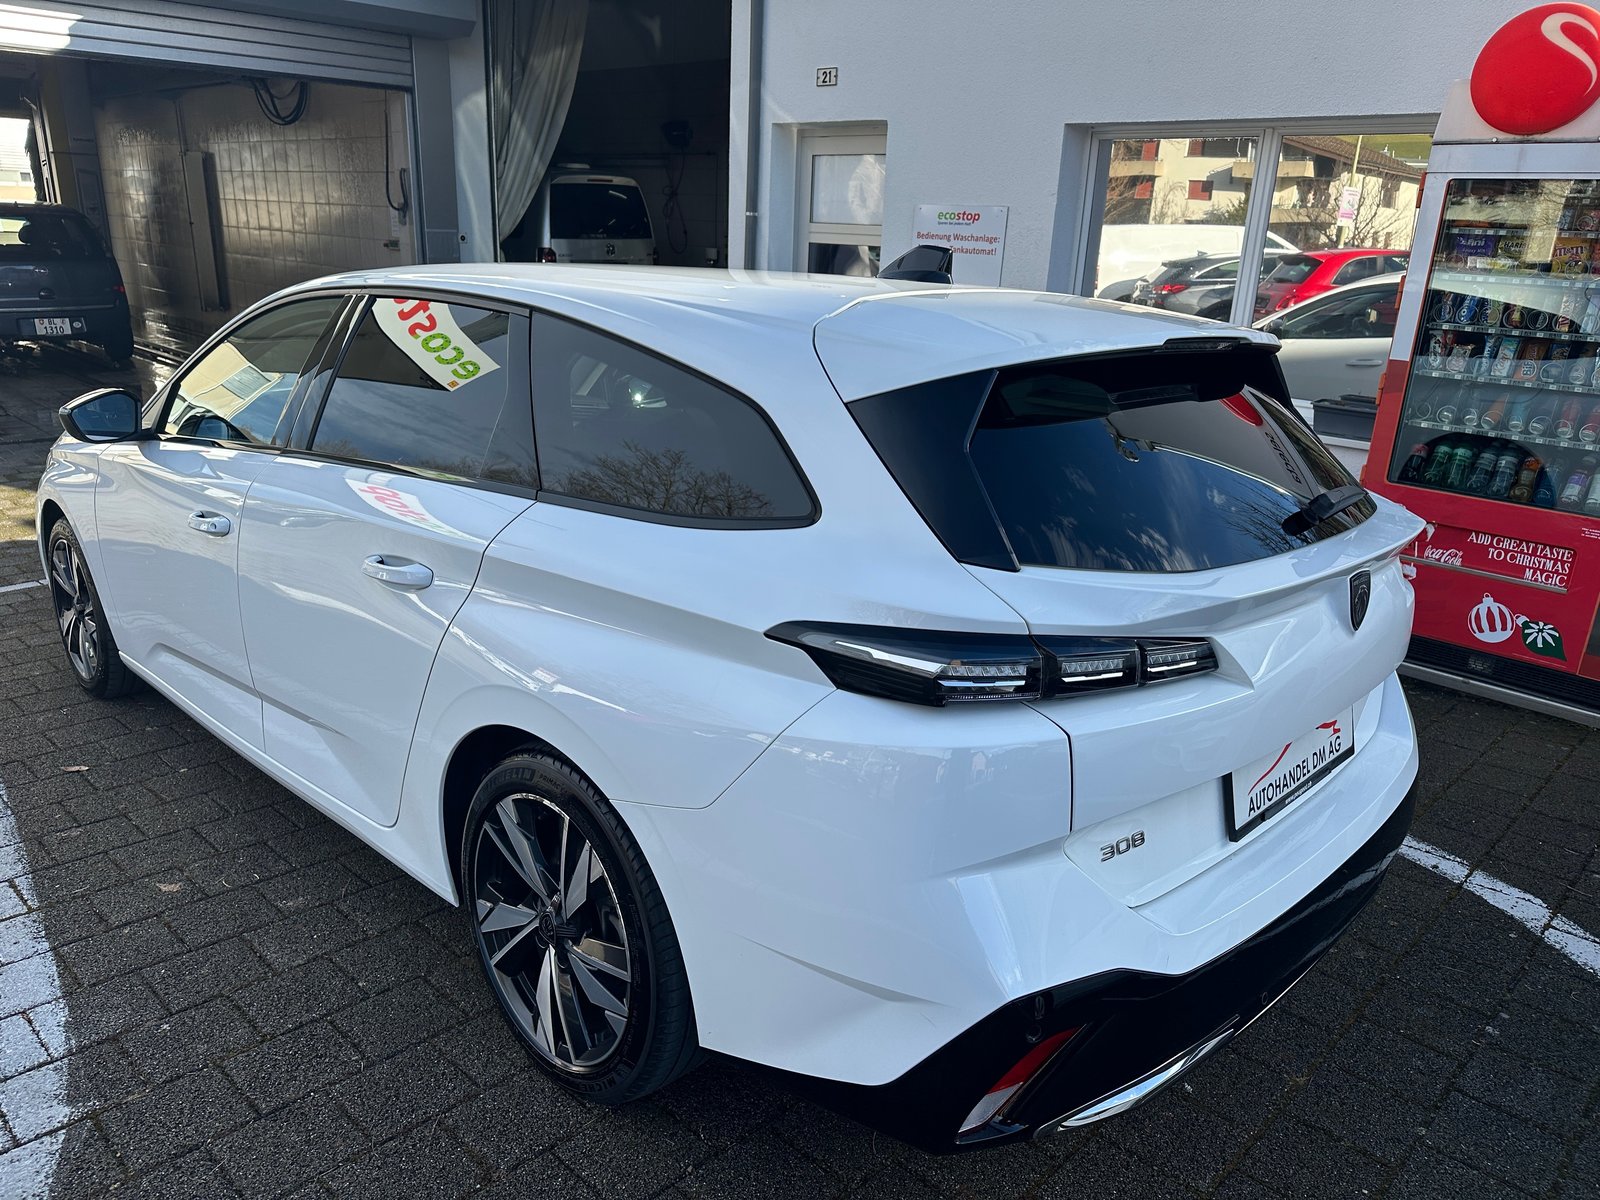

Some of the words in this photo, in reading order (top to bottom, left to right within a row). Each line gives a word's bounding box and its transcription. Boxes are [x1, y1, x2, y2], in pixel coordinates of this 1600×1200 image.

[821, 70, 832, 84] 21
[937, 210, 981, 224] ecostop
[916, 231, 952, 242] Bedienung
[953, 232, 1001, 244] Waschanlage:
[1503, 240, 1530, 250] HARI
[43, 325, 65, 335] 1310
[1423, 545, 1464, 566] Coca-Cola
[1467, 531, 1491, 546] ADD
[1493, 536, 1534, 553] GREAT
[1536, 543, 1573, 562] TASTE
[1487, 548, 1505, 561] TO
[1506, 551, 1571, 574] CHRISTMAS
[1524, 568, 1567, 587] MAGIC
[1247, 757, 1311, 817] AUTOHANDEL
[1312, 745, 1327, 770] DM
[1327, 735, 1342, 756] AG
[1100, 829, 1146, 863] 308
